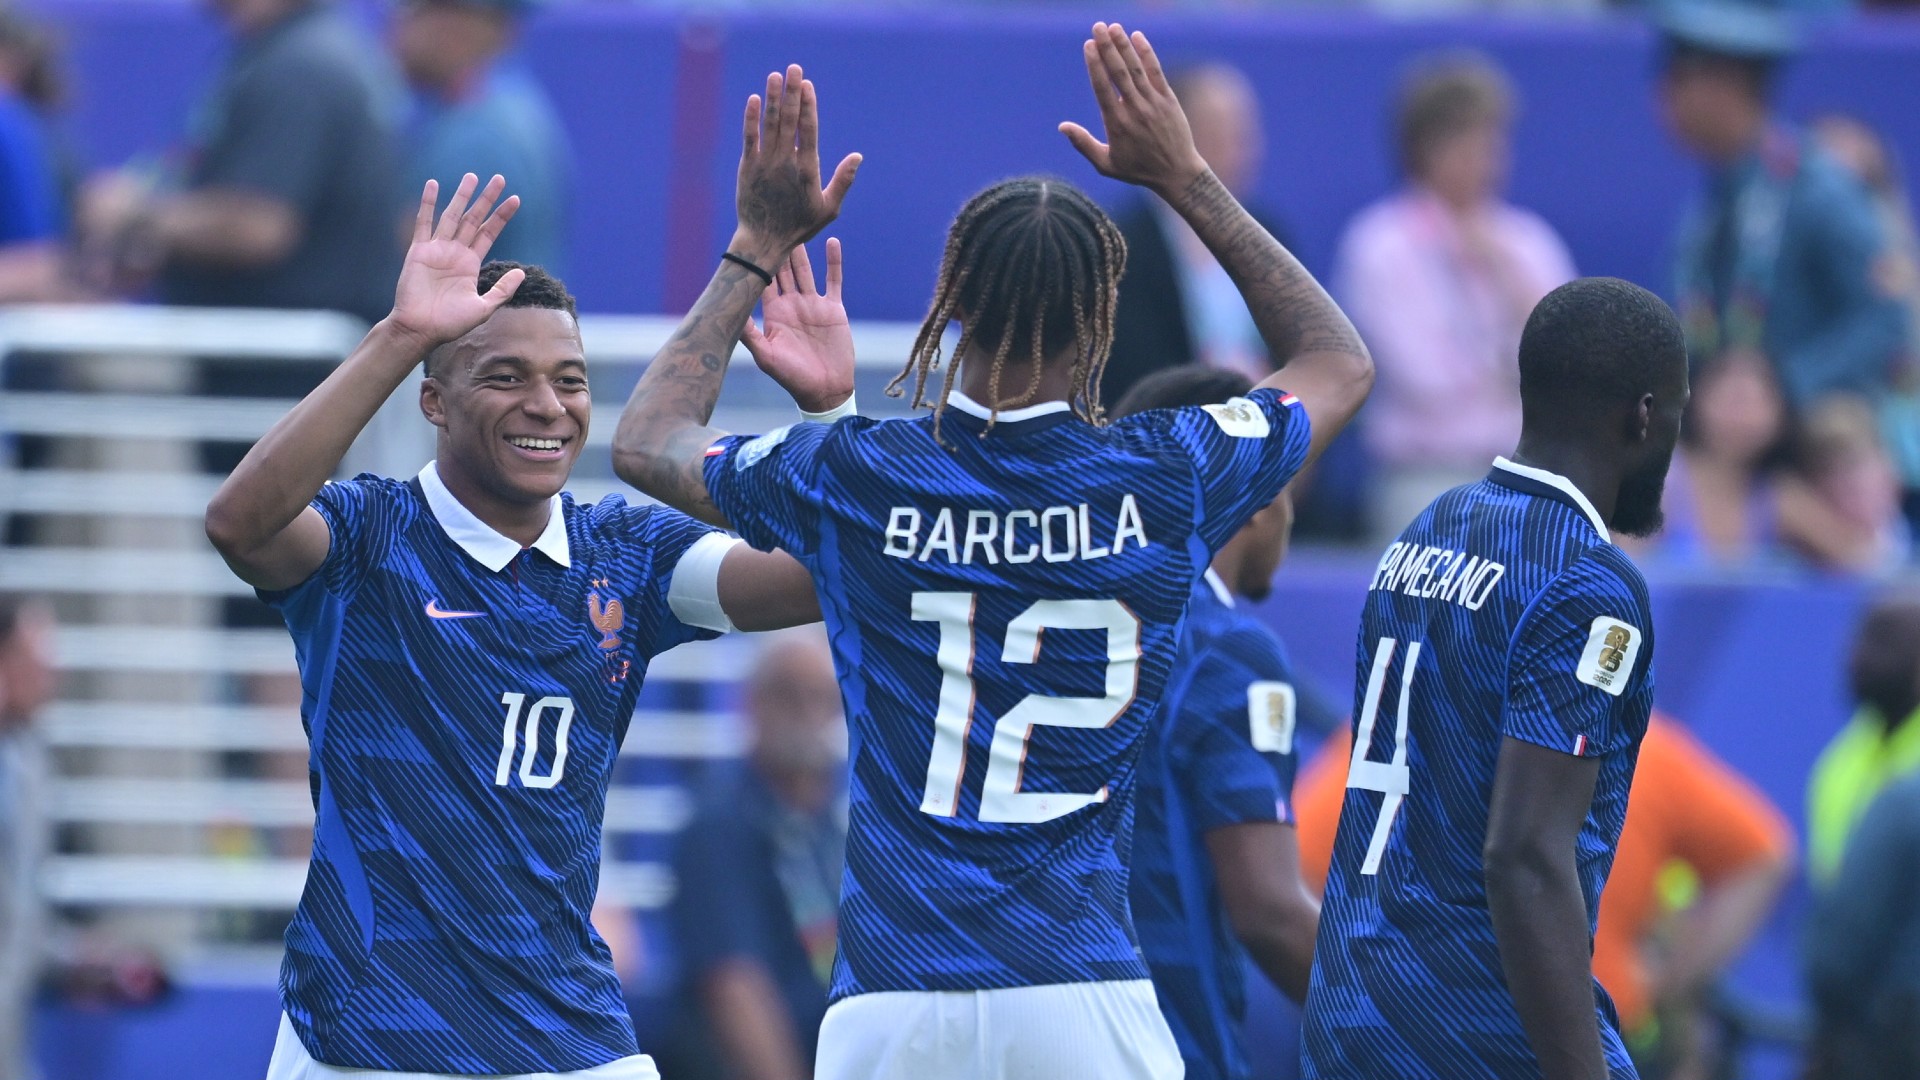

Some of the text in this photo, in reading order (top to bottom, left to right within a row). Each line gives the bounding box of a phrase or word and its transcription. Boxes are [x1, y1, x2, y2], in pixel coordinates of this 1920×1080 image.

[883, 494, 1149, 564] BARCOLA
[1369, 542, 1505, 611] PAMECANO
[911, 592, 1142, 824] 12
[1593, 673, 1613, 687] 2026
[495, 692, 575, 789] 10
[1346, 637, 1421, 875] 4
